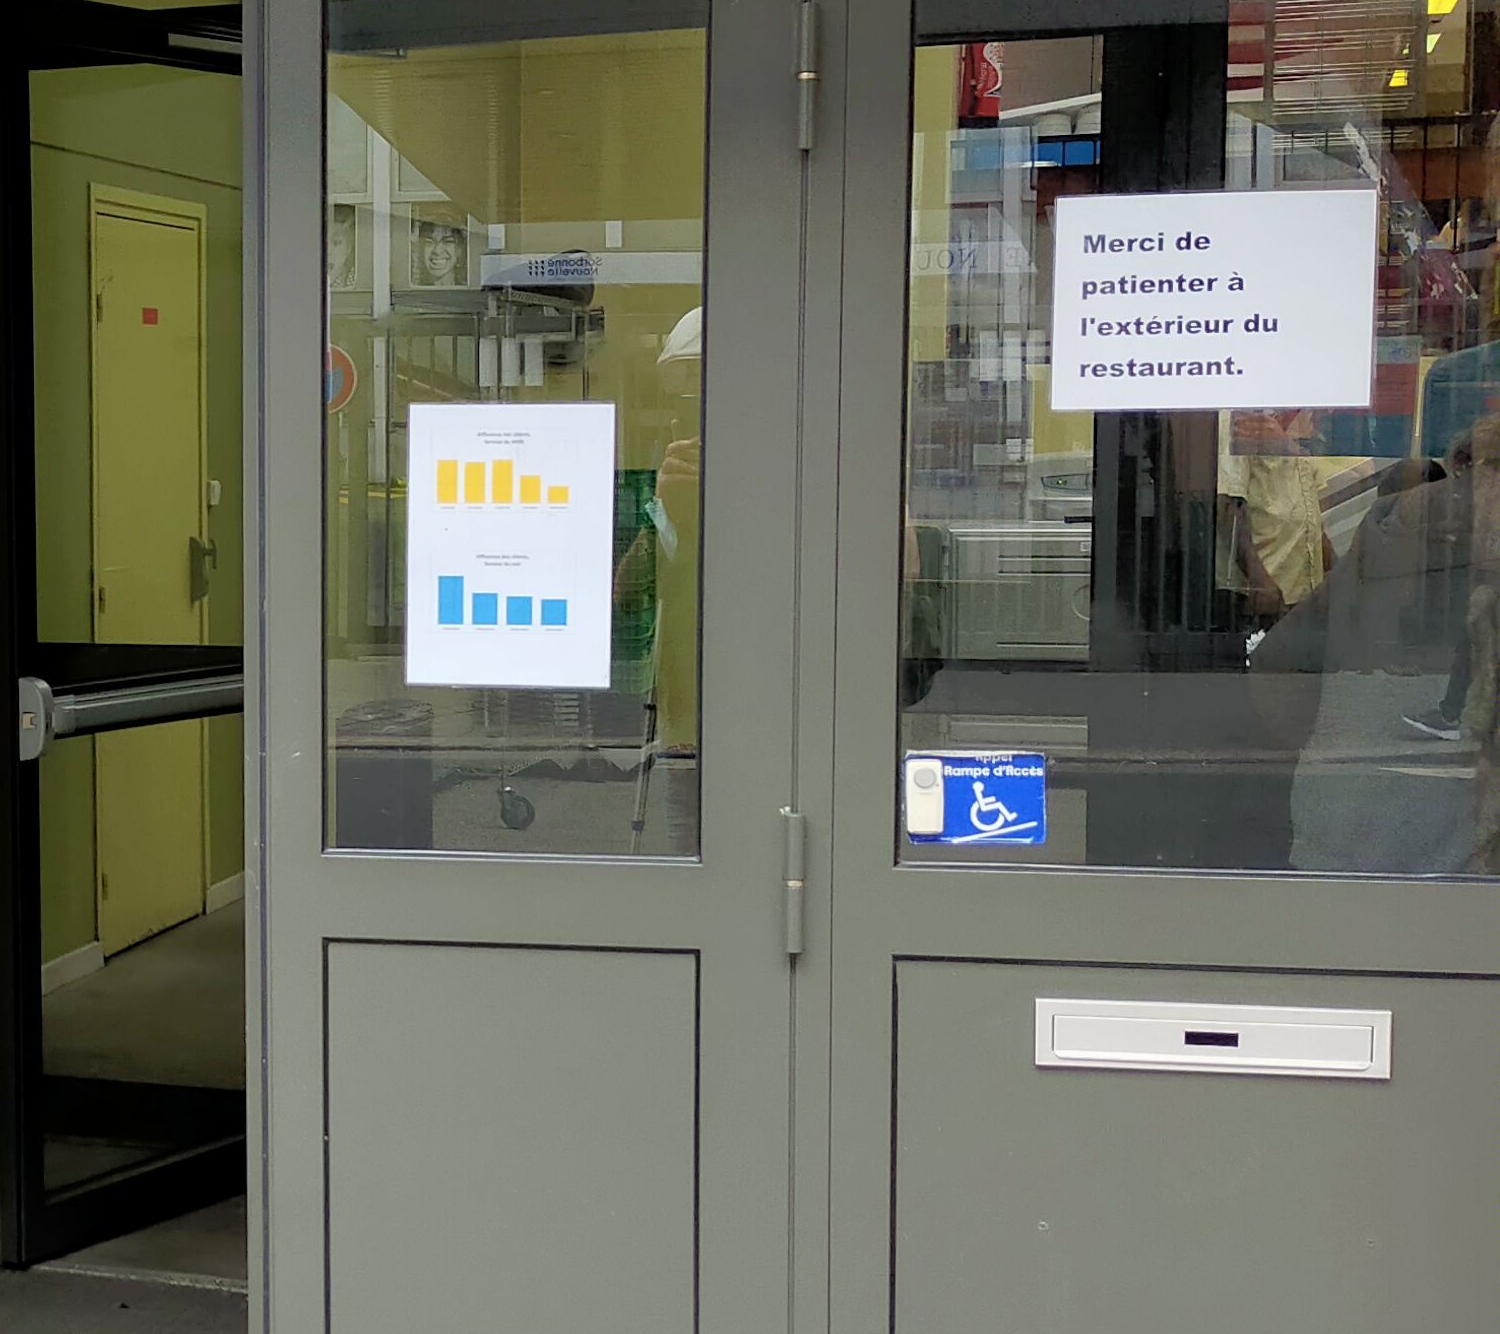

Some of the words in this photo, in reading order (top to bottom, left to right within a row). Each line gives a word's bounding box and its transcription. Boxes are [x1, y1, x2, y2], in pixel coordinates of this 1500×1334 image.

[1083, 232, 1165, 254] Merci
[1175, 231, 1211, 251] de
[1081, 273, 1218, 300] patienter
[1227, 271, 1245, 292] à
[1080, 315, 1234, 336] l'extérieur
[1243, 313, 1279, 333] du
[1079, 356, 1244, 378] restaurant.
[944, 765, 991, 779] Rampe
